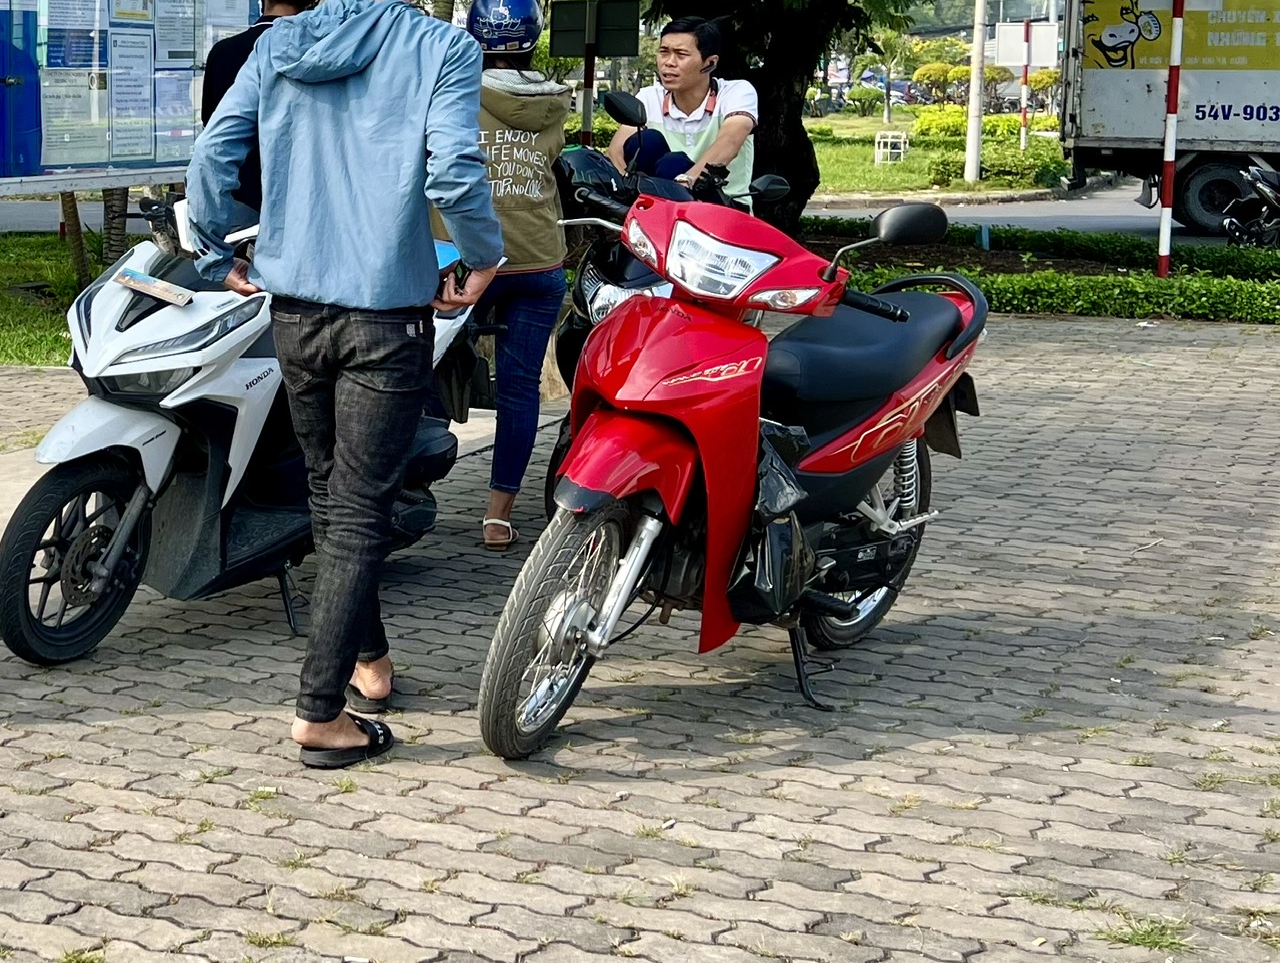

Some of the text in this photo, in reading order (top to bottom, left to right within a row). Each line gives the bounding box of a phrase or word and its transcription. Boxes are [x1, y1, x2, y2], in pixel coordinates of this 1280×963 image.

[1195, 104, 1280, 120] 54V-903
[477, 129, 540, 146] I ENJOY
[486, 144, 547, 167] IFE MOVES
[493, 161, 516, 177] YOU
[488, 177, 544, 198] TOP AND LOOK
[244, 367, 275, 391] HONDA
